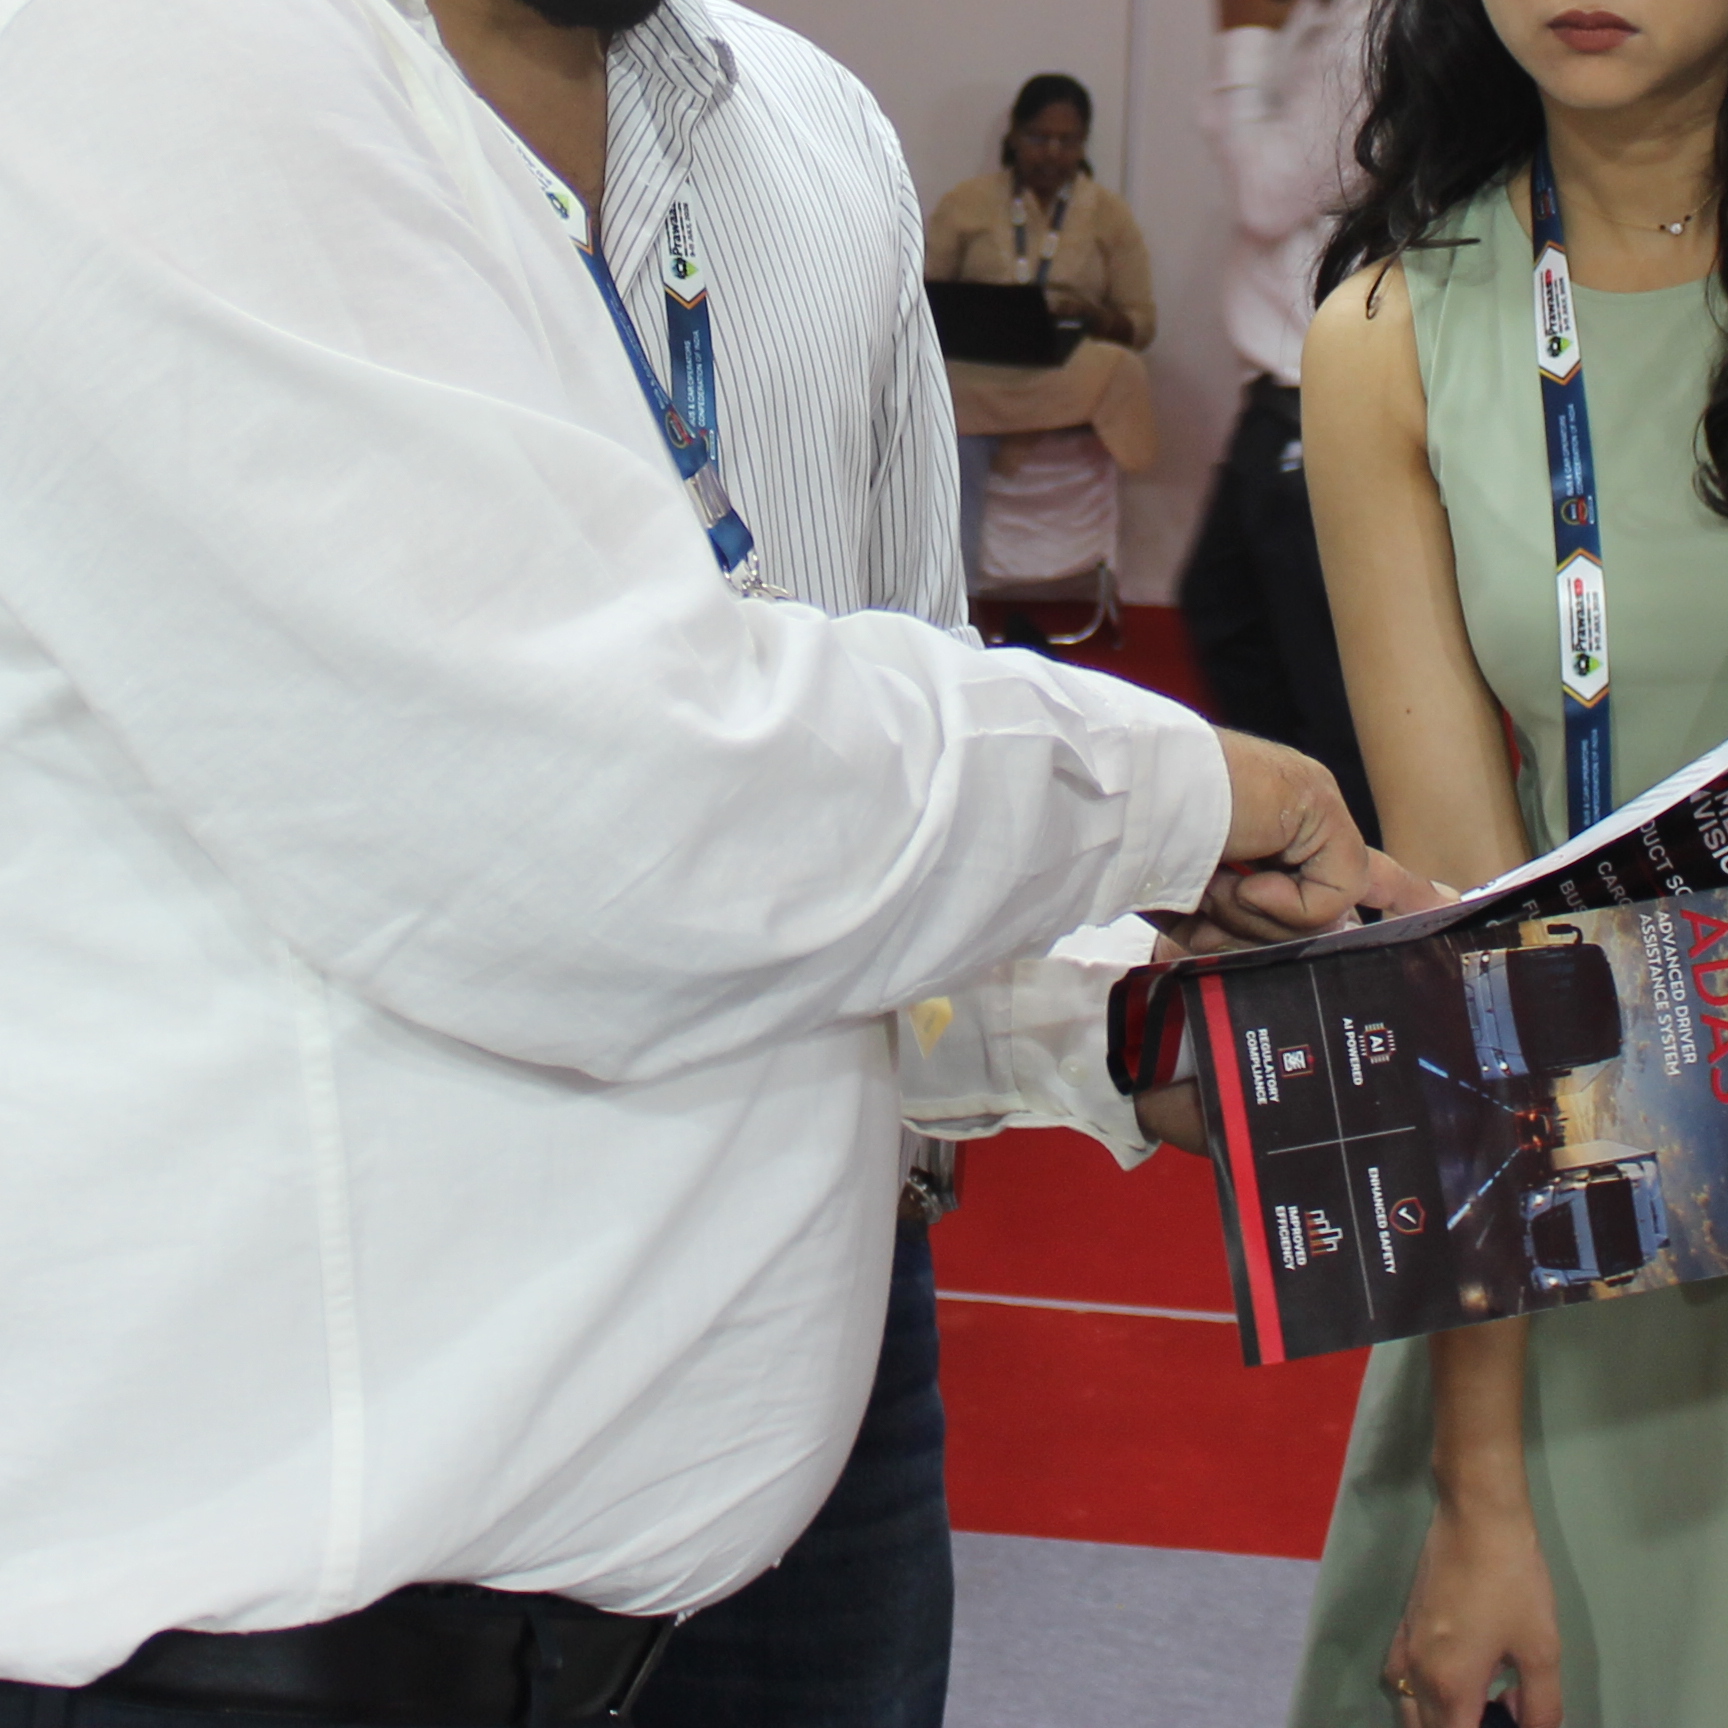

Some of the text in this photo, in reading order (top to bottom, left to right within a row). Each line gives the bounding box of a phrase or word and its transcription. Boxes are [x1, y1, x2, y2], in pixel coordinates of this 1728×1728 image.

[669, 200, 684, 257] Prawaa
[1638, 913, 1681, 1076] ASSISTANCE SYSTEM
[1657, 910, 1698, 1065] ADVANCED DRIVER
[1245, 1030, 1269, 1106] COMPLIANCE
[1257, 1027, 1280, 1103] REGULATORY
[1343, 1032, 1364, 1086] POWERED
[1368, 1034, 1385, 1053] AI
[1274, 1205, 1296, 1271] EFFICIENCY
[1287, 1205, 1308, 1267] IMPROVED
[1367, 1166, 1397, 1275] ENHANCED SAFETY
